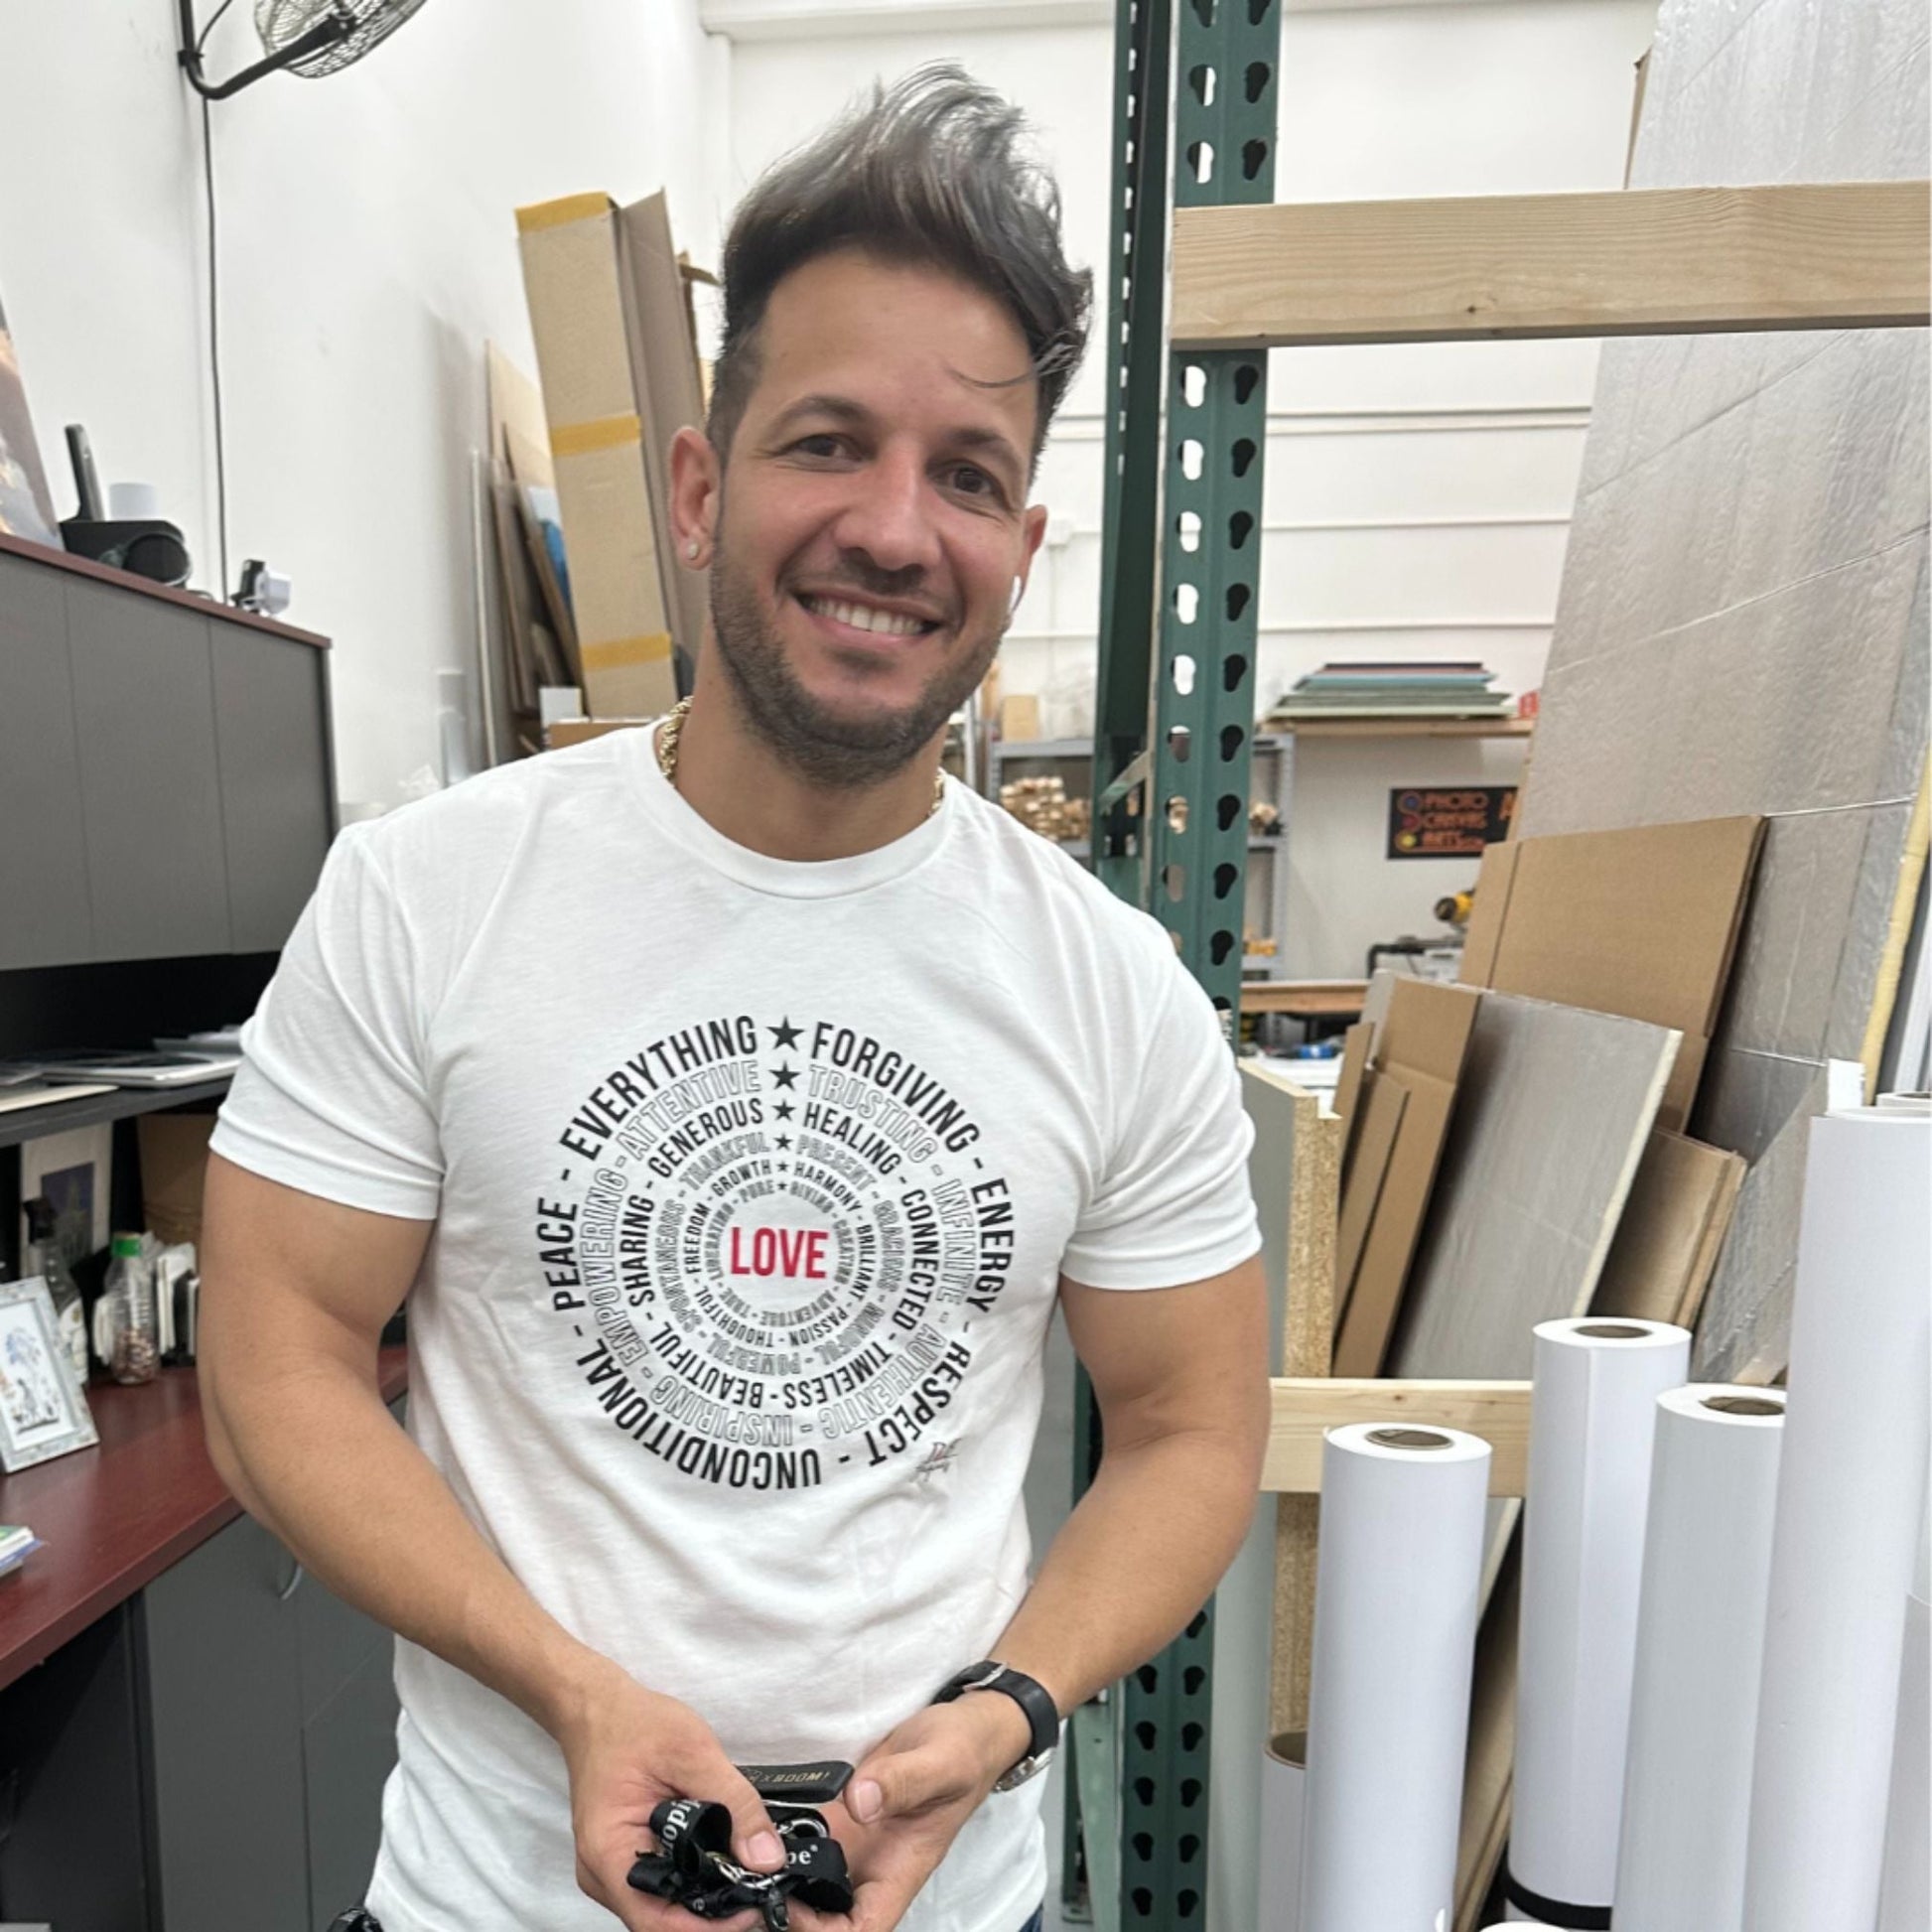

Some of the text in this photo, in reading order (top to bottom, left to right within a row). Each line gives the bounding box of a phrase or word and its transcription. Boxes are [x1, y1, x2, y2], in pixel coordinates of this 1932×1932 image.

[679, 1132, 770, 1189] THANKFUL
[796, 1134, 877, 1189] PRESENT
[536, 1016, 1014, 1489] FORGIVING ENERGY RESPECT UNCONDITIONAL PEACE EVERYTHING
[581, 1060, 976, 1448] TRUSTING INFINITE AUTHENTIC INSPIRING EMPOWERING ATTENTIVE
[620, 1098, 940, 1409] HEALING CONNECTED TIMELESS BEAUTIFUL SHARING GENEROUS
[683, 1160, 876, 1347] HARMONY BRILLIANT PASSION THOUGHTFUL FREEDOM GROWTH
[731, 1227, 829, 1279] LOVE
[772, 1771, 831, 1783] BOOM!
